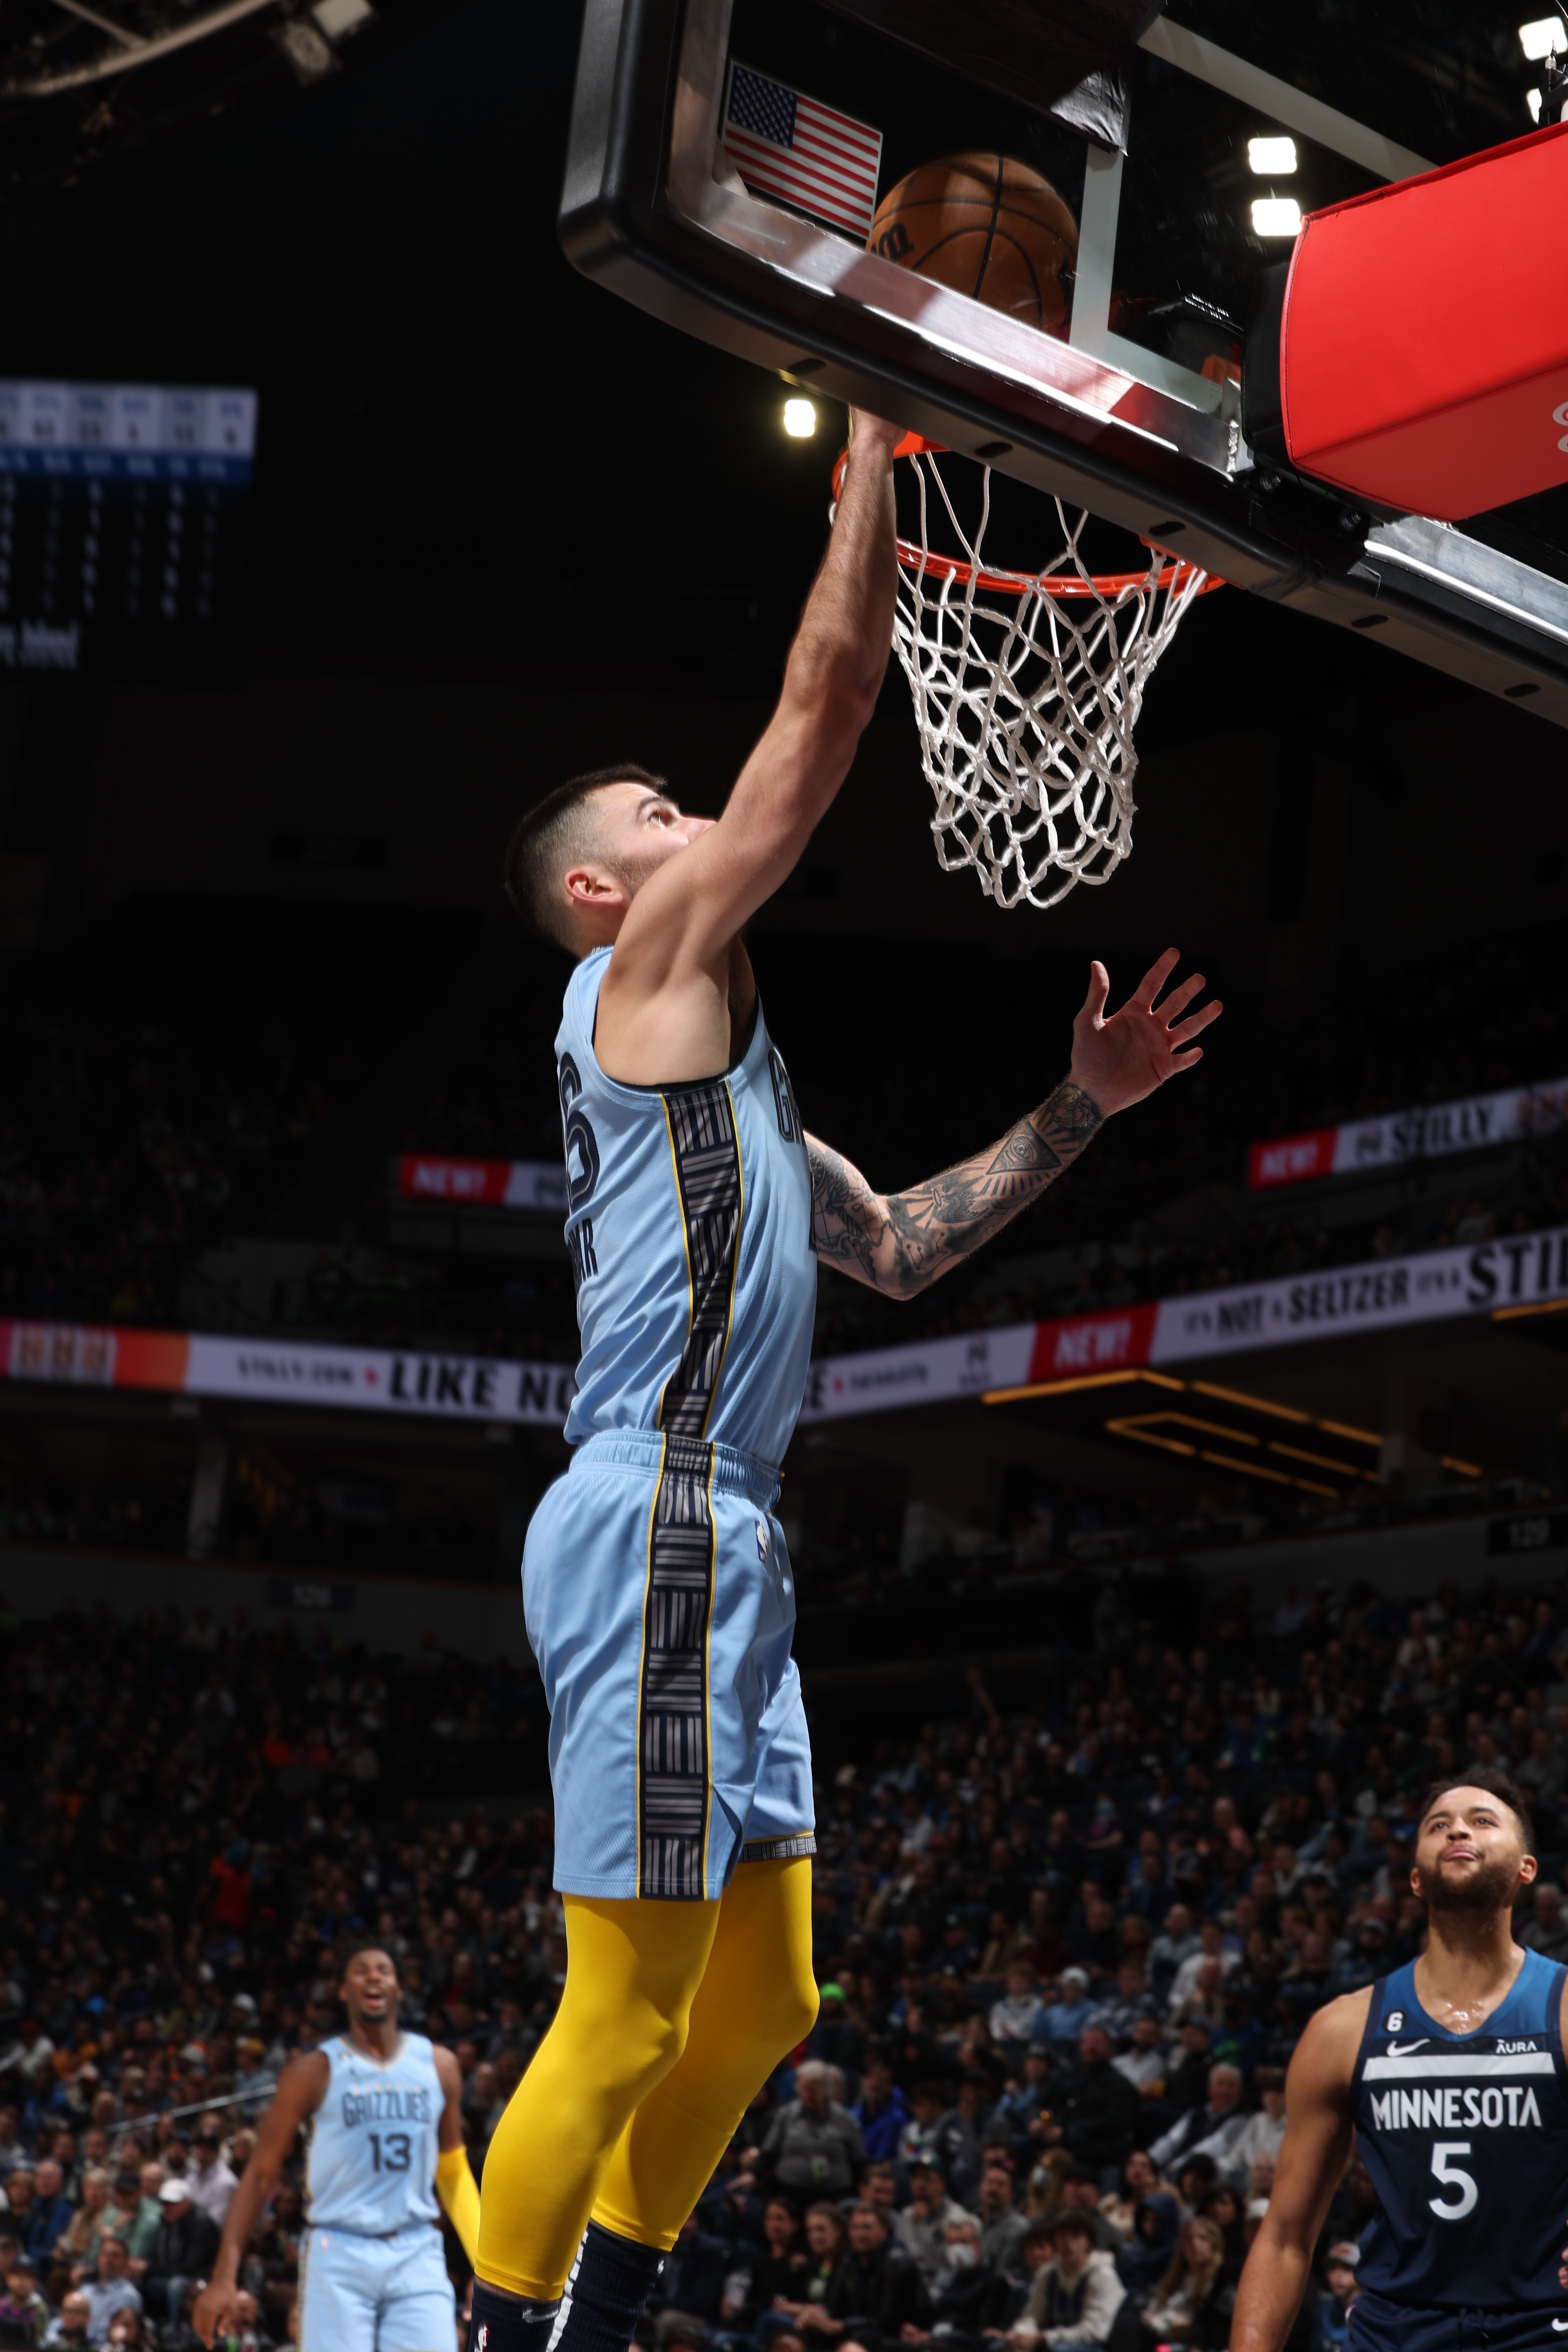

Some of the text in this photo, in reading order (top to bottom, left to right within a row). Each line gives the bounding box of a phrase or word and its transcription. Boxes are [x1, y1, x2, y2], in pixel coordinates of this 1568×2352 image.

[1289, 1267, 1409, 1323] SELTZER
[389, 1356, 498, 1408] LIKE
[1386, 2012, 1404, 2032] 6
[342, 2090, 430, 2128] GRIZZLIES
[1370, 2087, 1542, 2131] MINNESOTA
[368, 2132, 412, 2173] 13
[1428, 2142, 1478, 2220] 5
